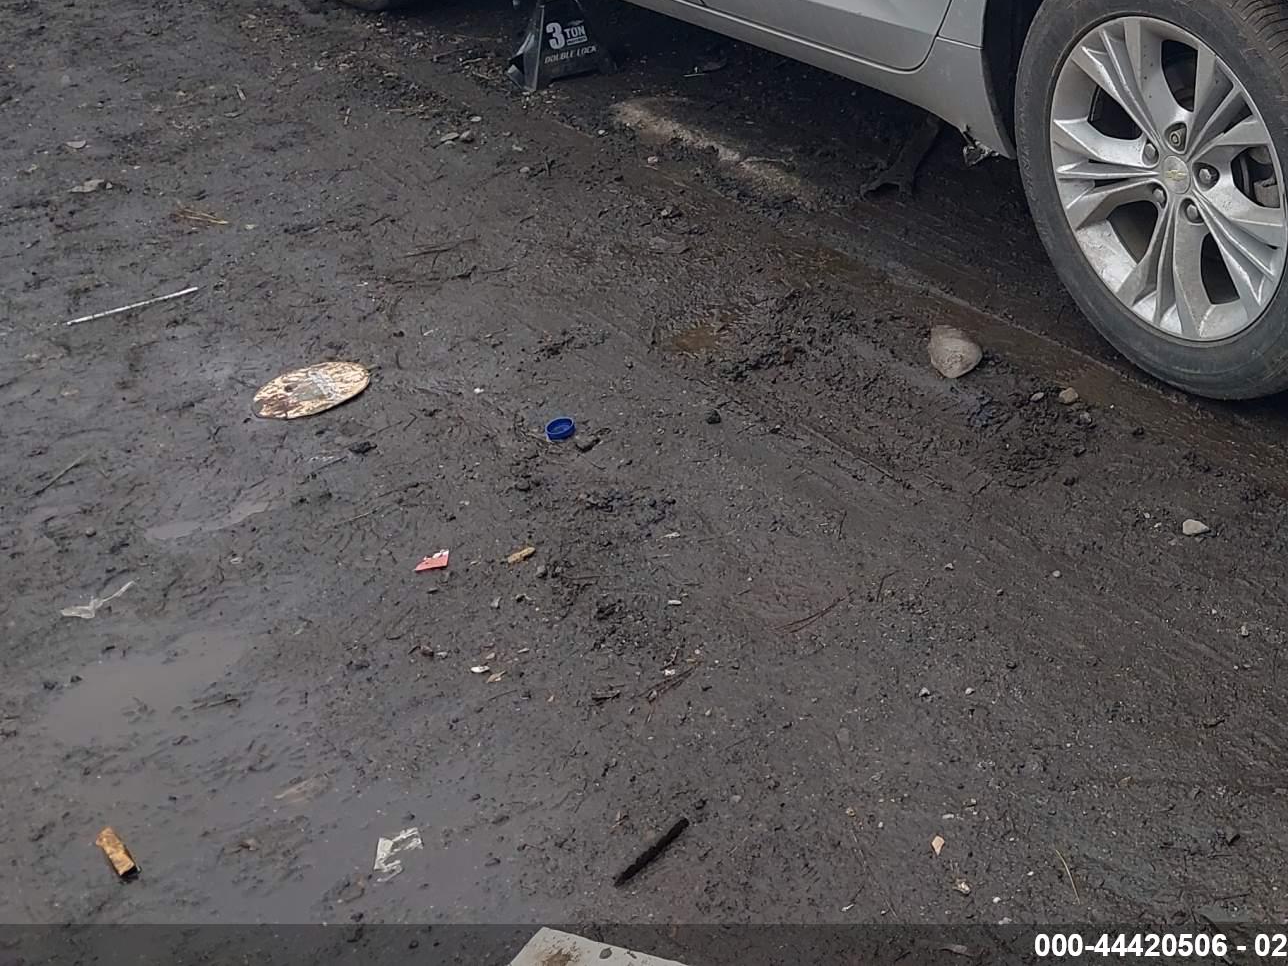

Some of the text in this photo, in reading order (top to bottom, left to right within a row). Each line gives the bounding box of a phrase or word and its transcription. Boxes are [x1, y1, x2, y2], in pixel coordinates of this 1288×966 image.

[545, 22, 566, 50] 3
[563, 25, 586, 38] TON
[544, 45, 597, 63] DOUBLE LOCK
